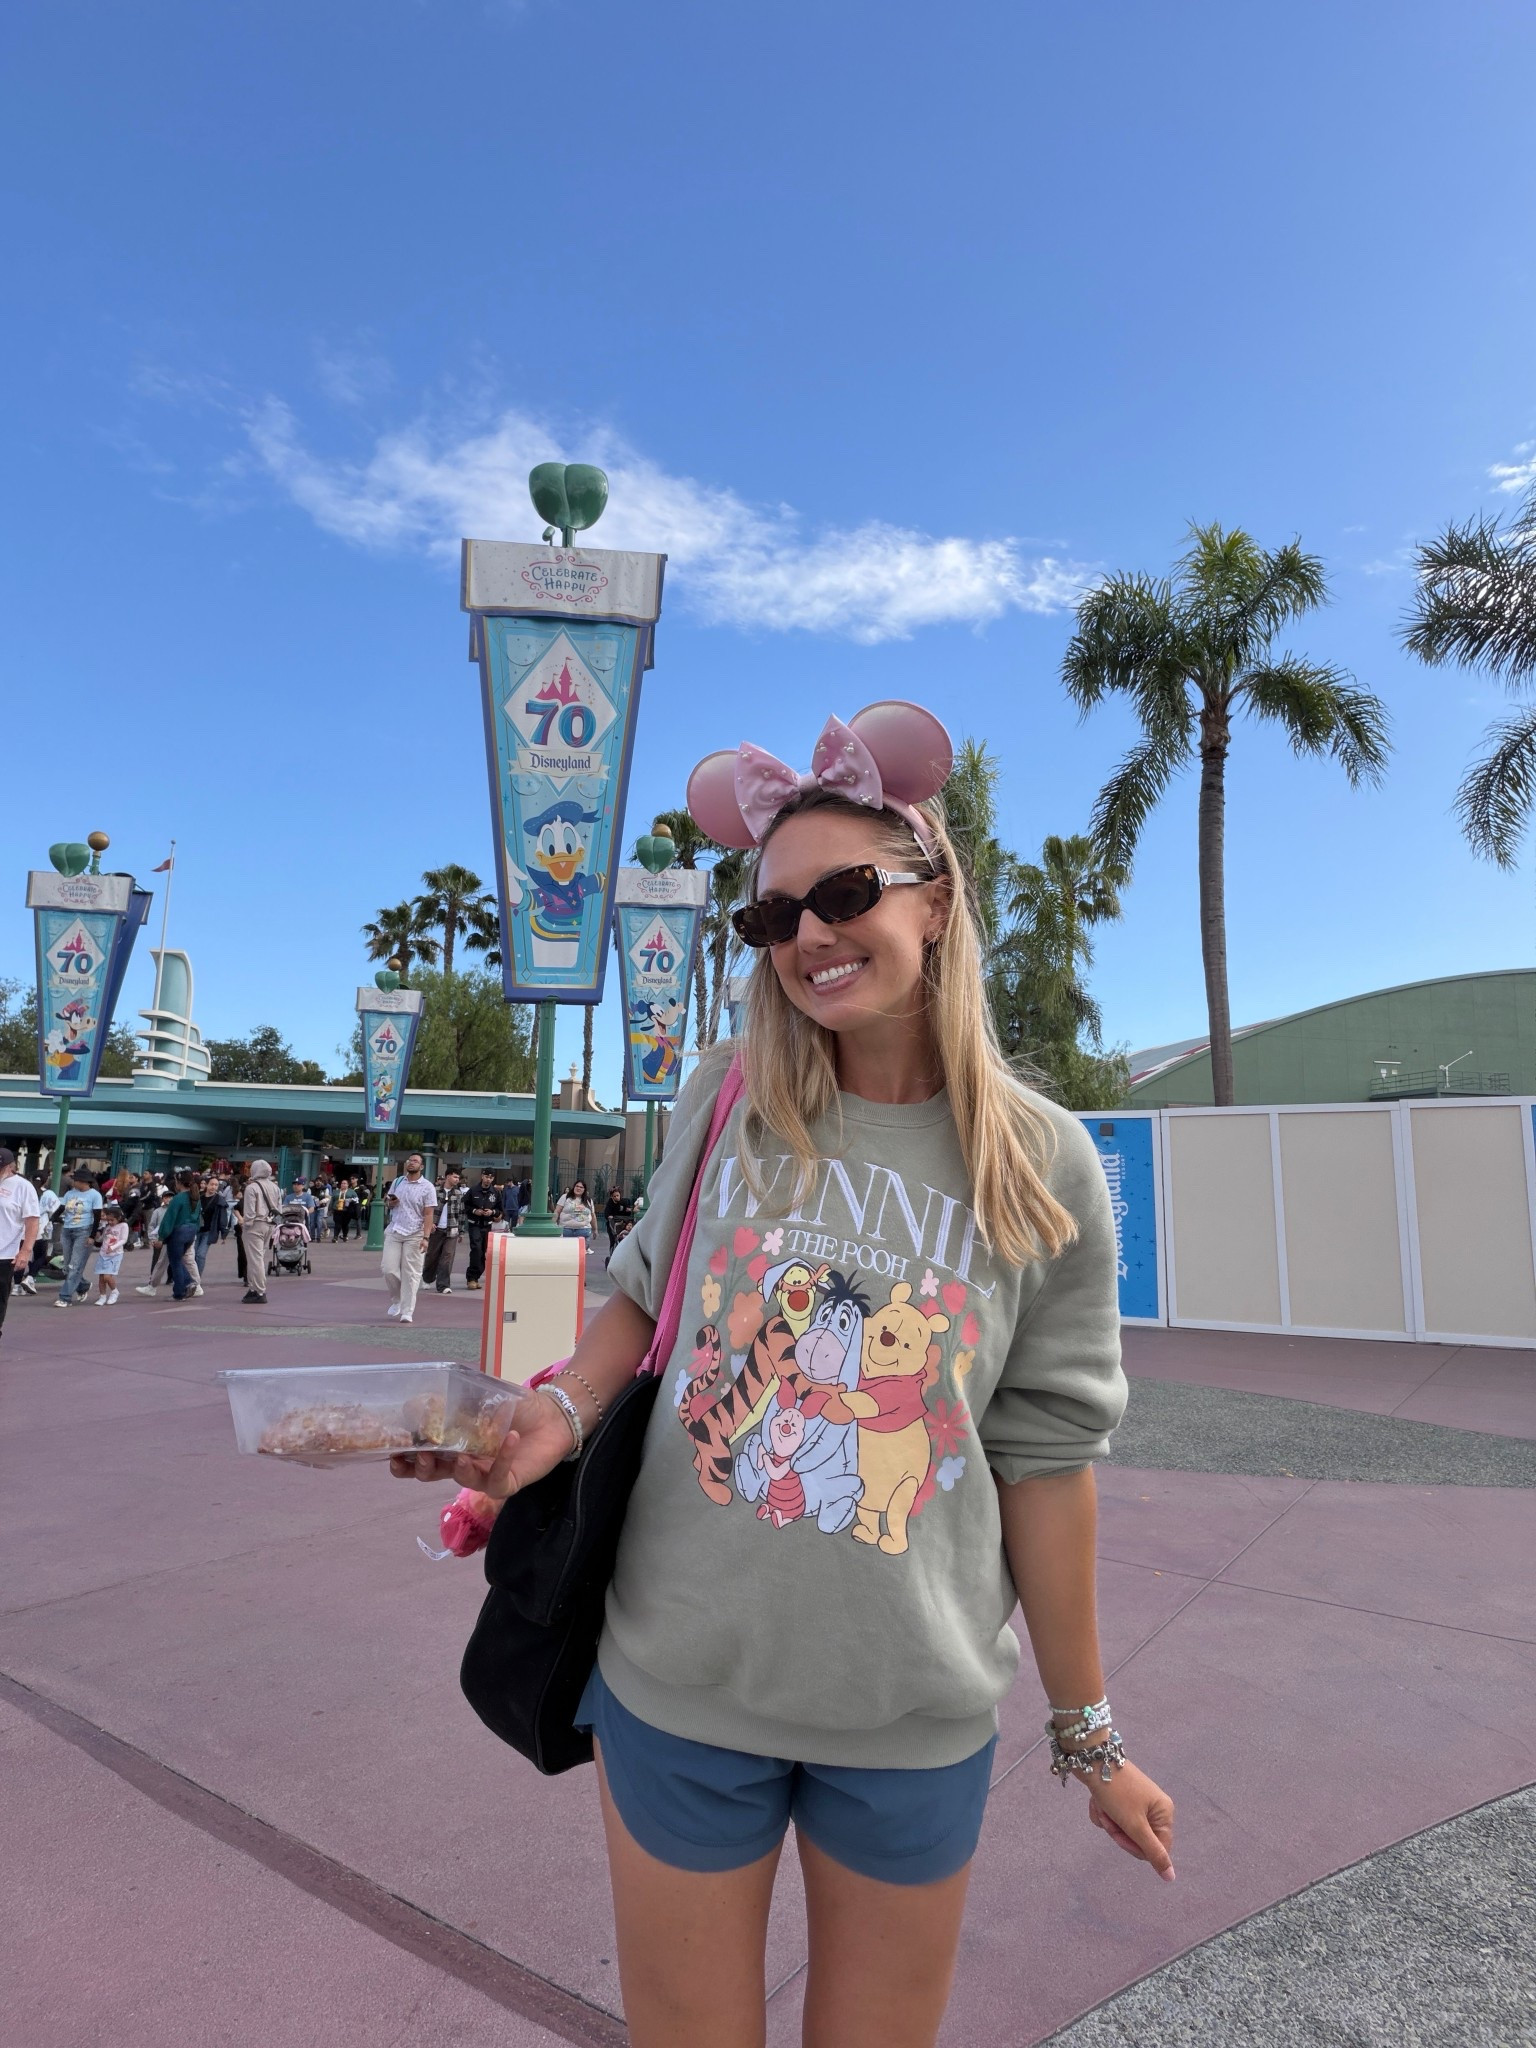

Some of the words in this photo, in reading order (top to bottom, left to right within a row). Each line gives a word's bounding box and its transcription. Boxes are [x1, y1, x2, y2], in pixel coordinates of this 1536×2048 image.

[531, 566, 598, 581] CELEBRATE
[544, 577, 586, 593] HAPPY
[525, 699, 597, 748] 70
[529, 751, 591, 772] Disneyland
[57, 951, 94, 974] 70
[640, 949, 675, 973] 70
[375, 1039, 398, 1054] 70
[788, 1229, 838, 1260] THE
[838, 1240, 911, 1281] POOH
